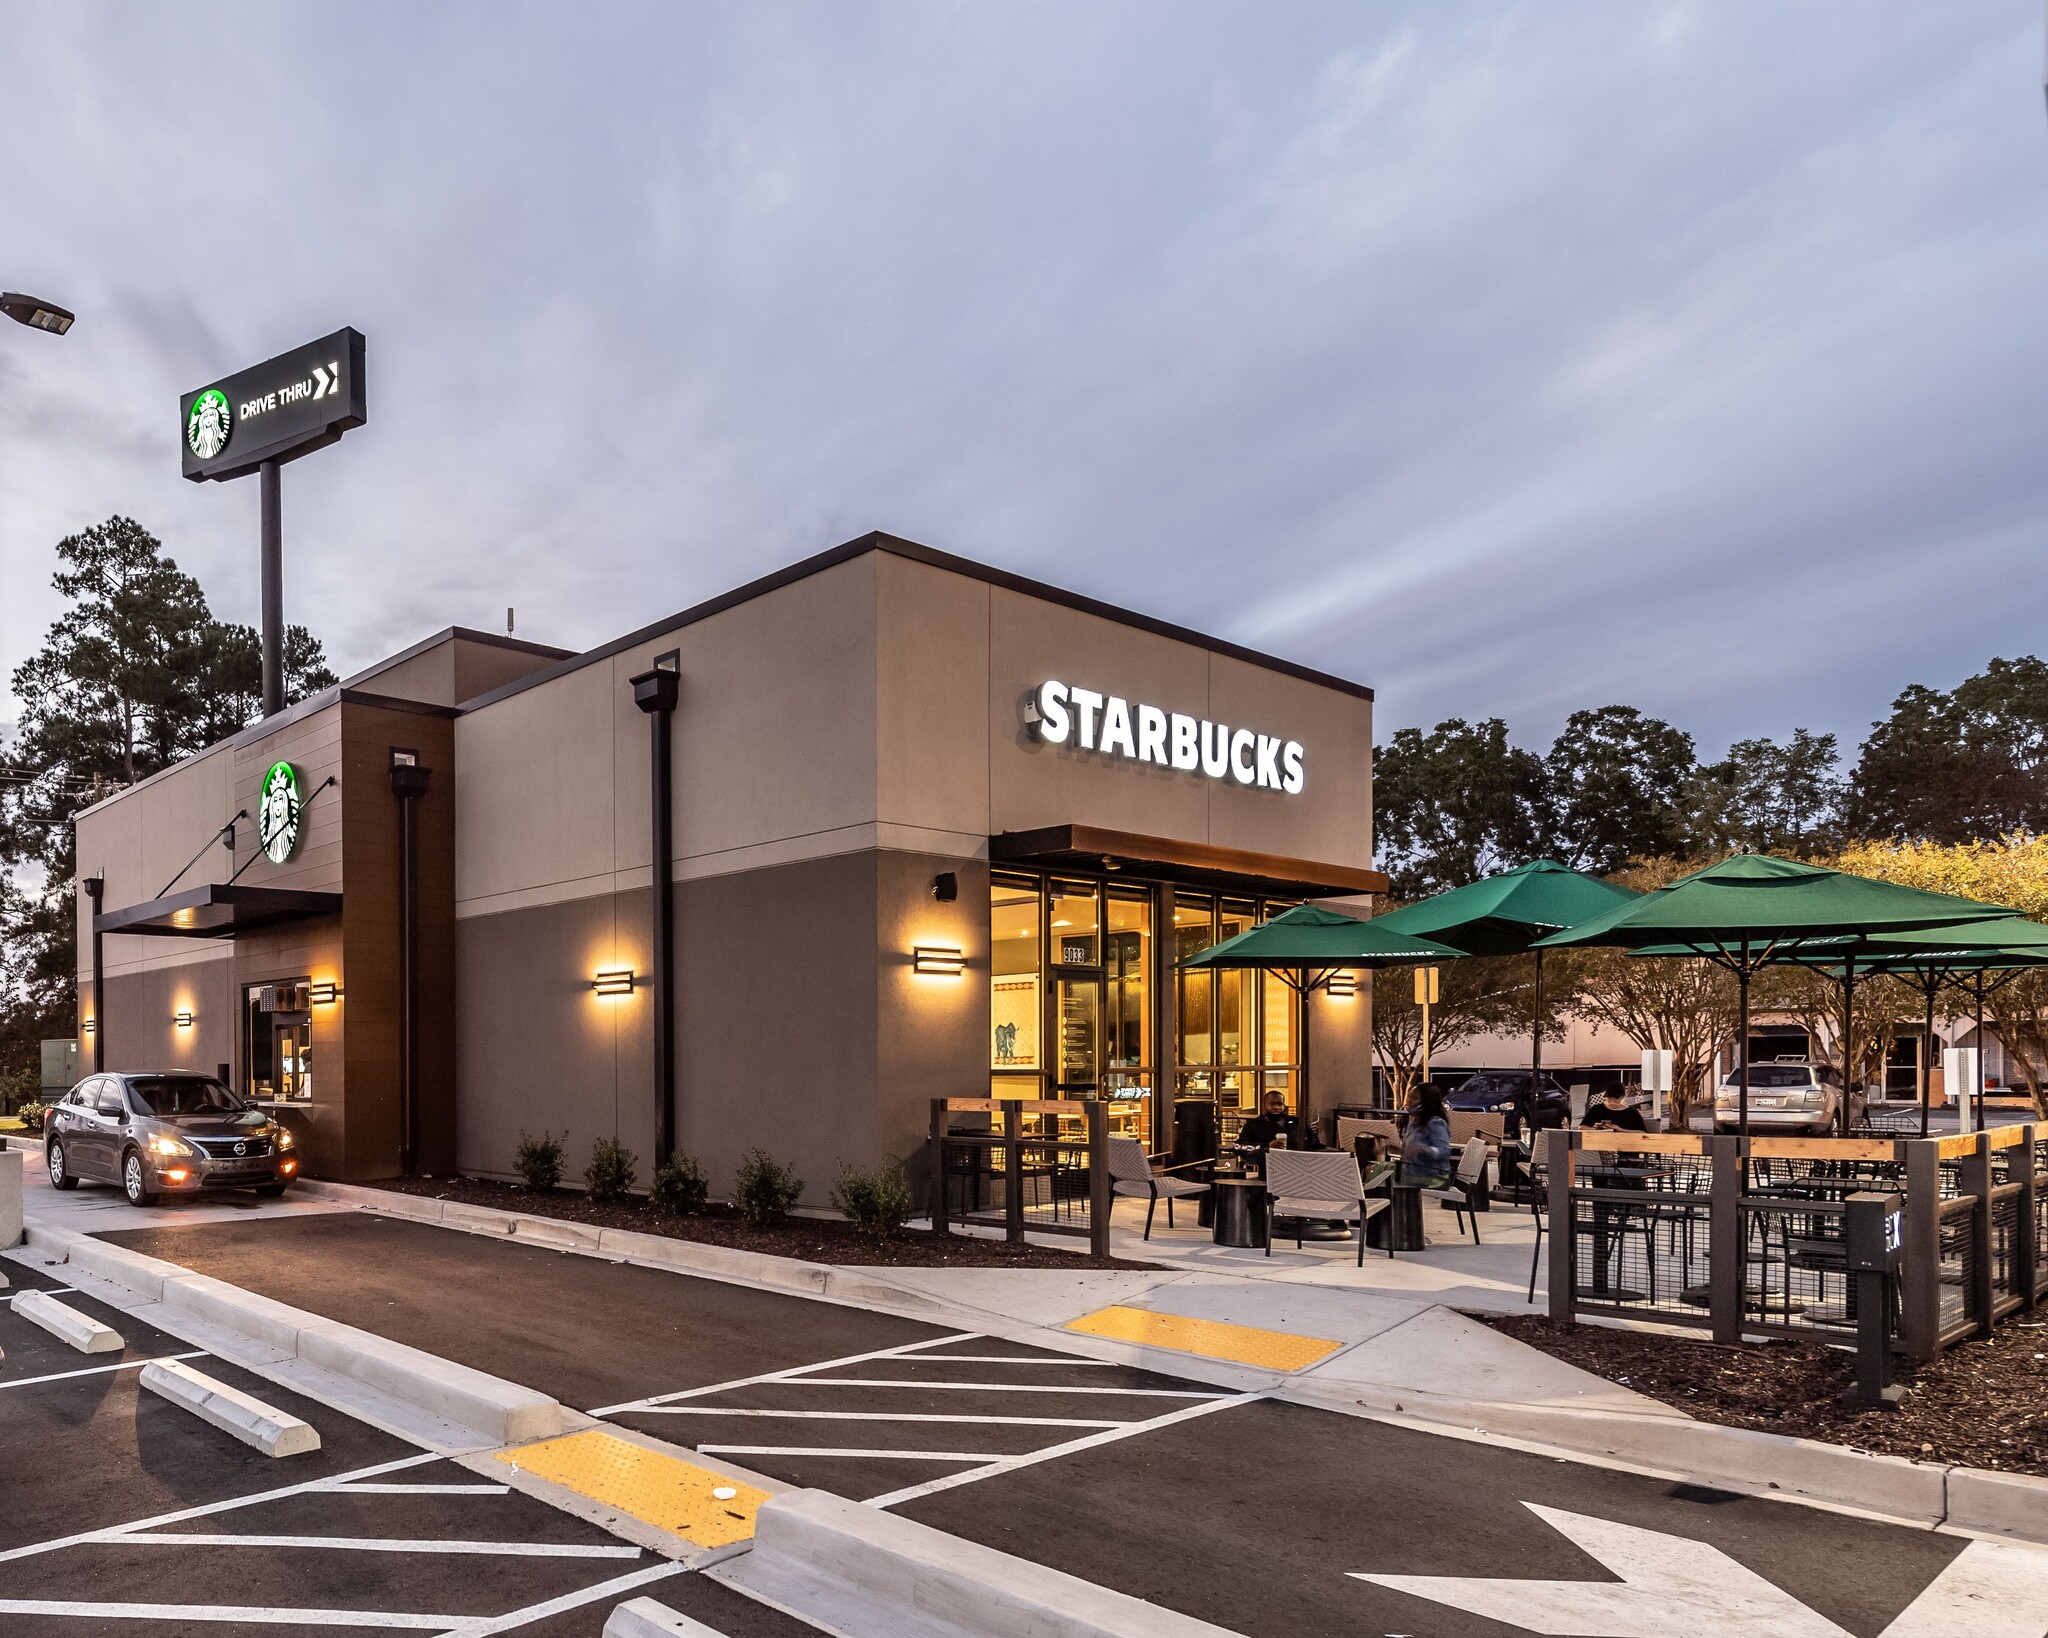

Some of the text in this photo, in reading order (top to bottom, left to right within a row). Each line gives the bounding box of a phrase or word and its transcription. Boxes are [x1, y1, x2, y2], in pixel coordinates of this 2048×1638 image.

[240, 379, 312, 420] DRIVE THRU
[1039, 680, 1304, 794] STARBUCKS
[1064, 947, 1084, 963] 9033
